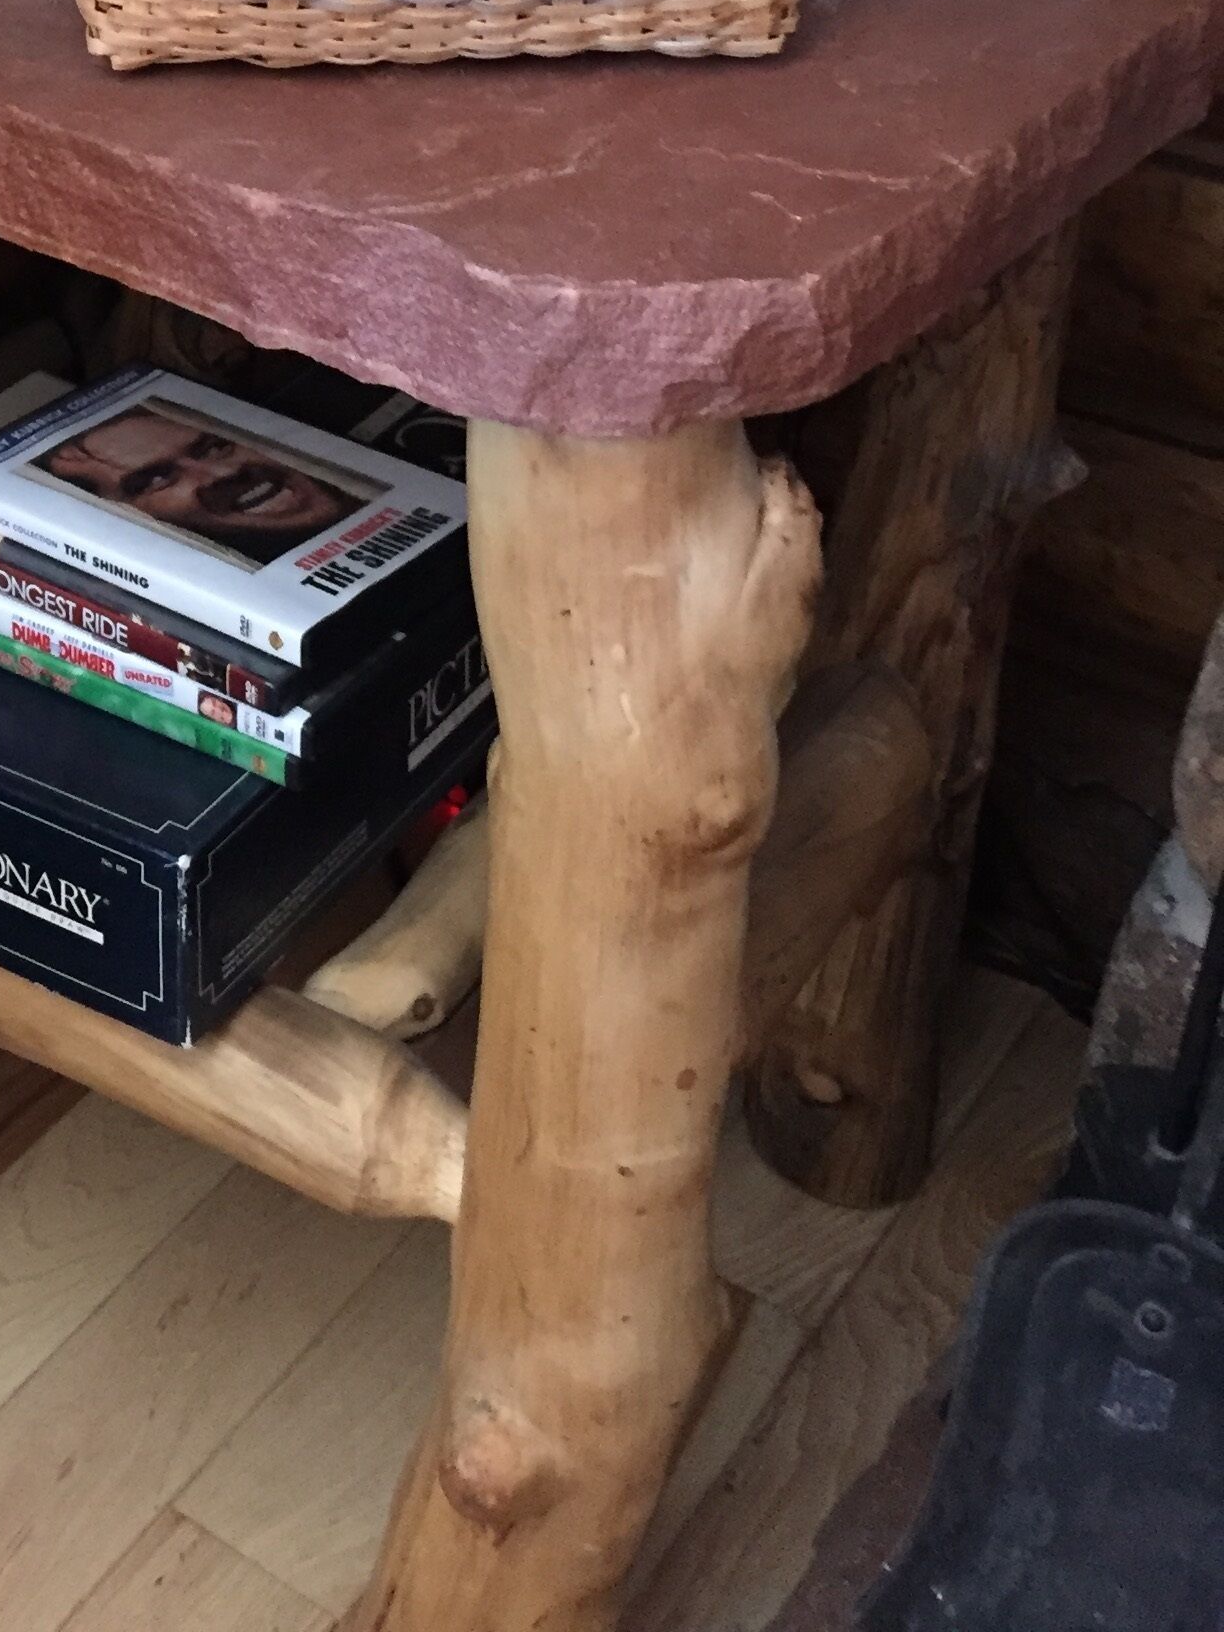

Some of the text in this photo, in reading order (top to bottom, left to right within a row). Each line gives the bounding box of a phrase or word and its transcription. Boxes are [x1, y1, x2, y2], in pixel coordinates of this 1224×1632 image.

[63, 543, 150, 589] THE SHINING
[300, 506, 452, 596] THE SHINING
[82, 605, 129, 648] RIDE
[11, 620, 117, 681] DUMB DUMBER
[123, 669, 172, 689] UNRATED
